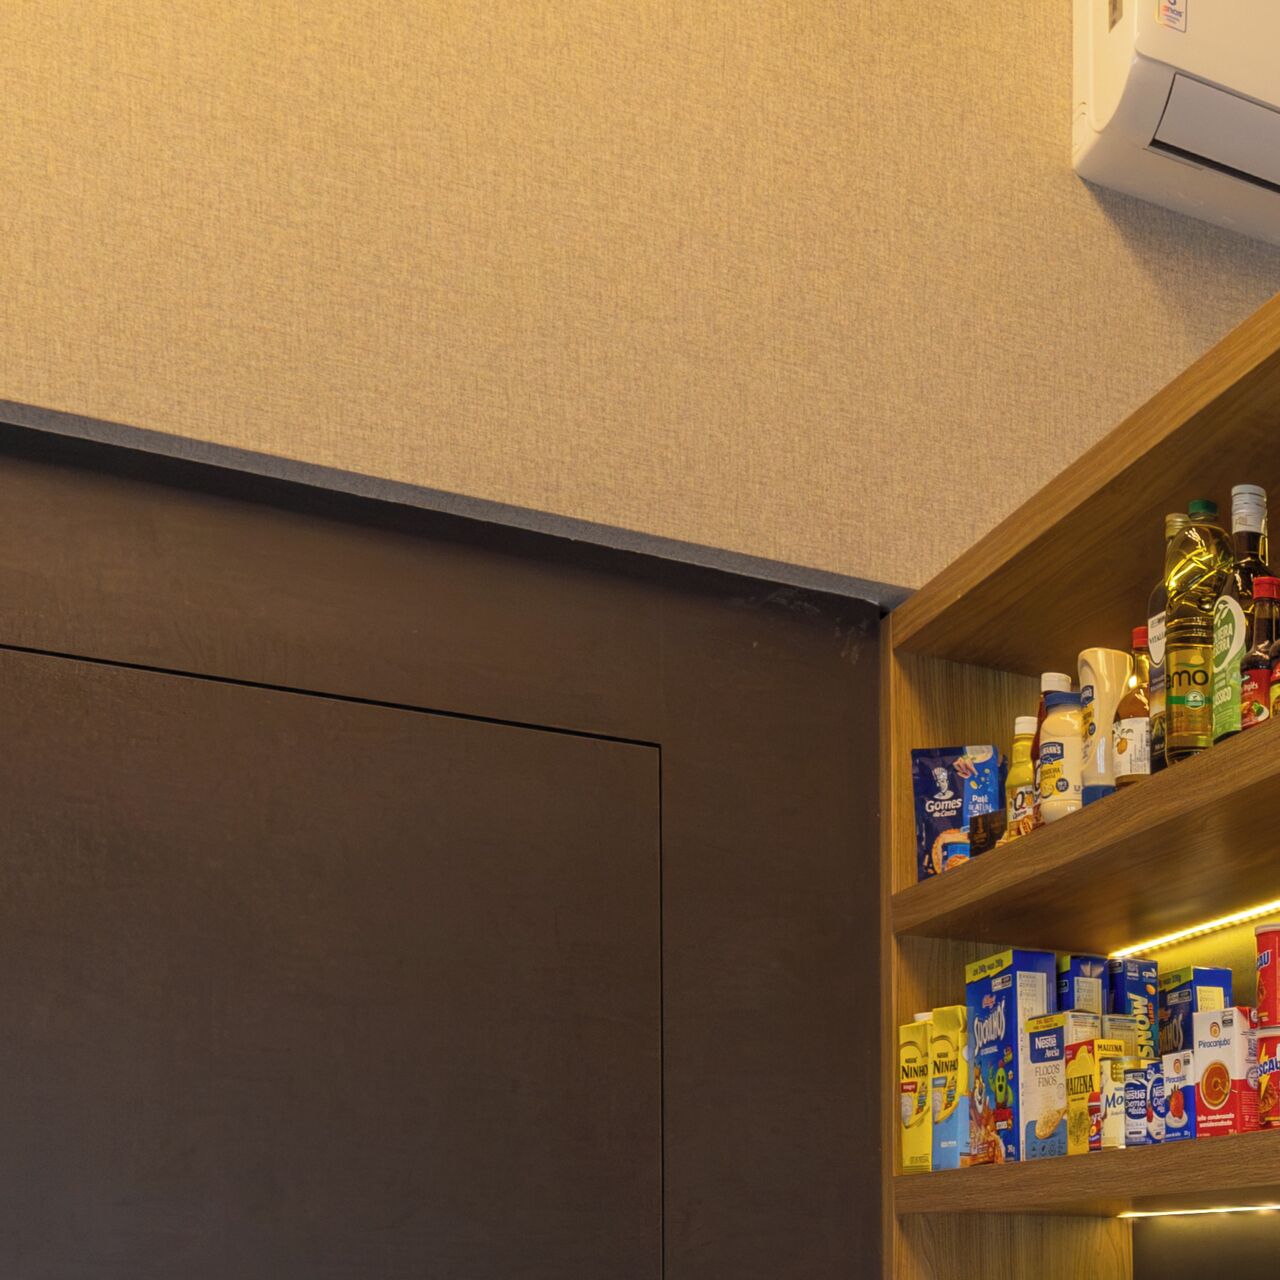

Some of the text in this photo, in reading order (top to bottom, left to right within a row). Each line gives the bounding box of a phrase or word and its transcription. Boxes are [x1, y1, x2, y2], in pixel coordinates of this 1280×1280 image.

[925, 797, 963, 813] Gomes
[1097, 1043, 1123, 1053] MAIZENA
[1198, 1038, 1231, 1049] Piracanjuba
[902, 1065, 928, 1081] NINHO
[933, 1059, 958, 1076] NINHO
[1035, 1063, 1060, 1077] FLOCOS
[1038, 1075, 1057, 1088] FINOS
